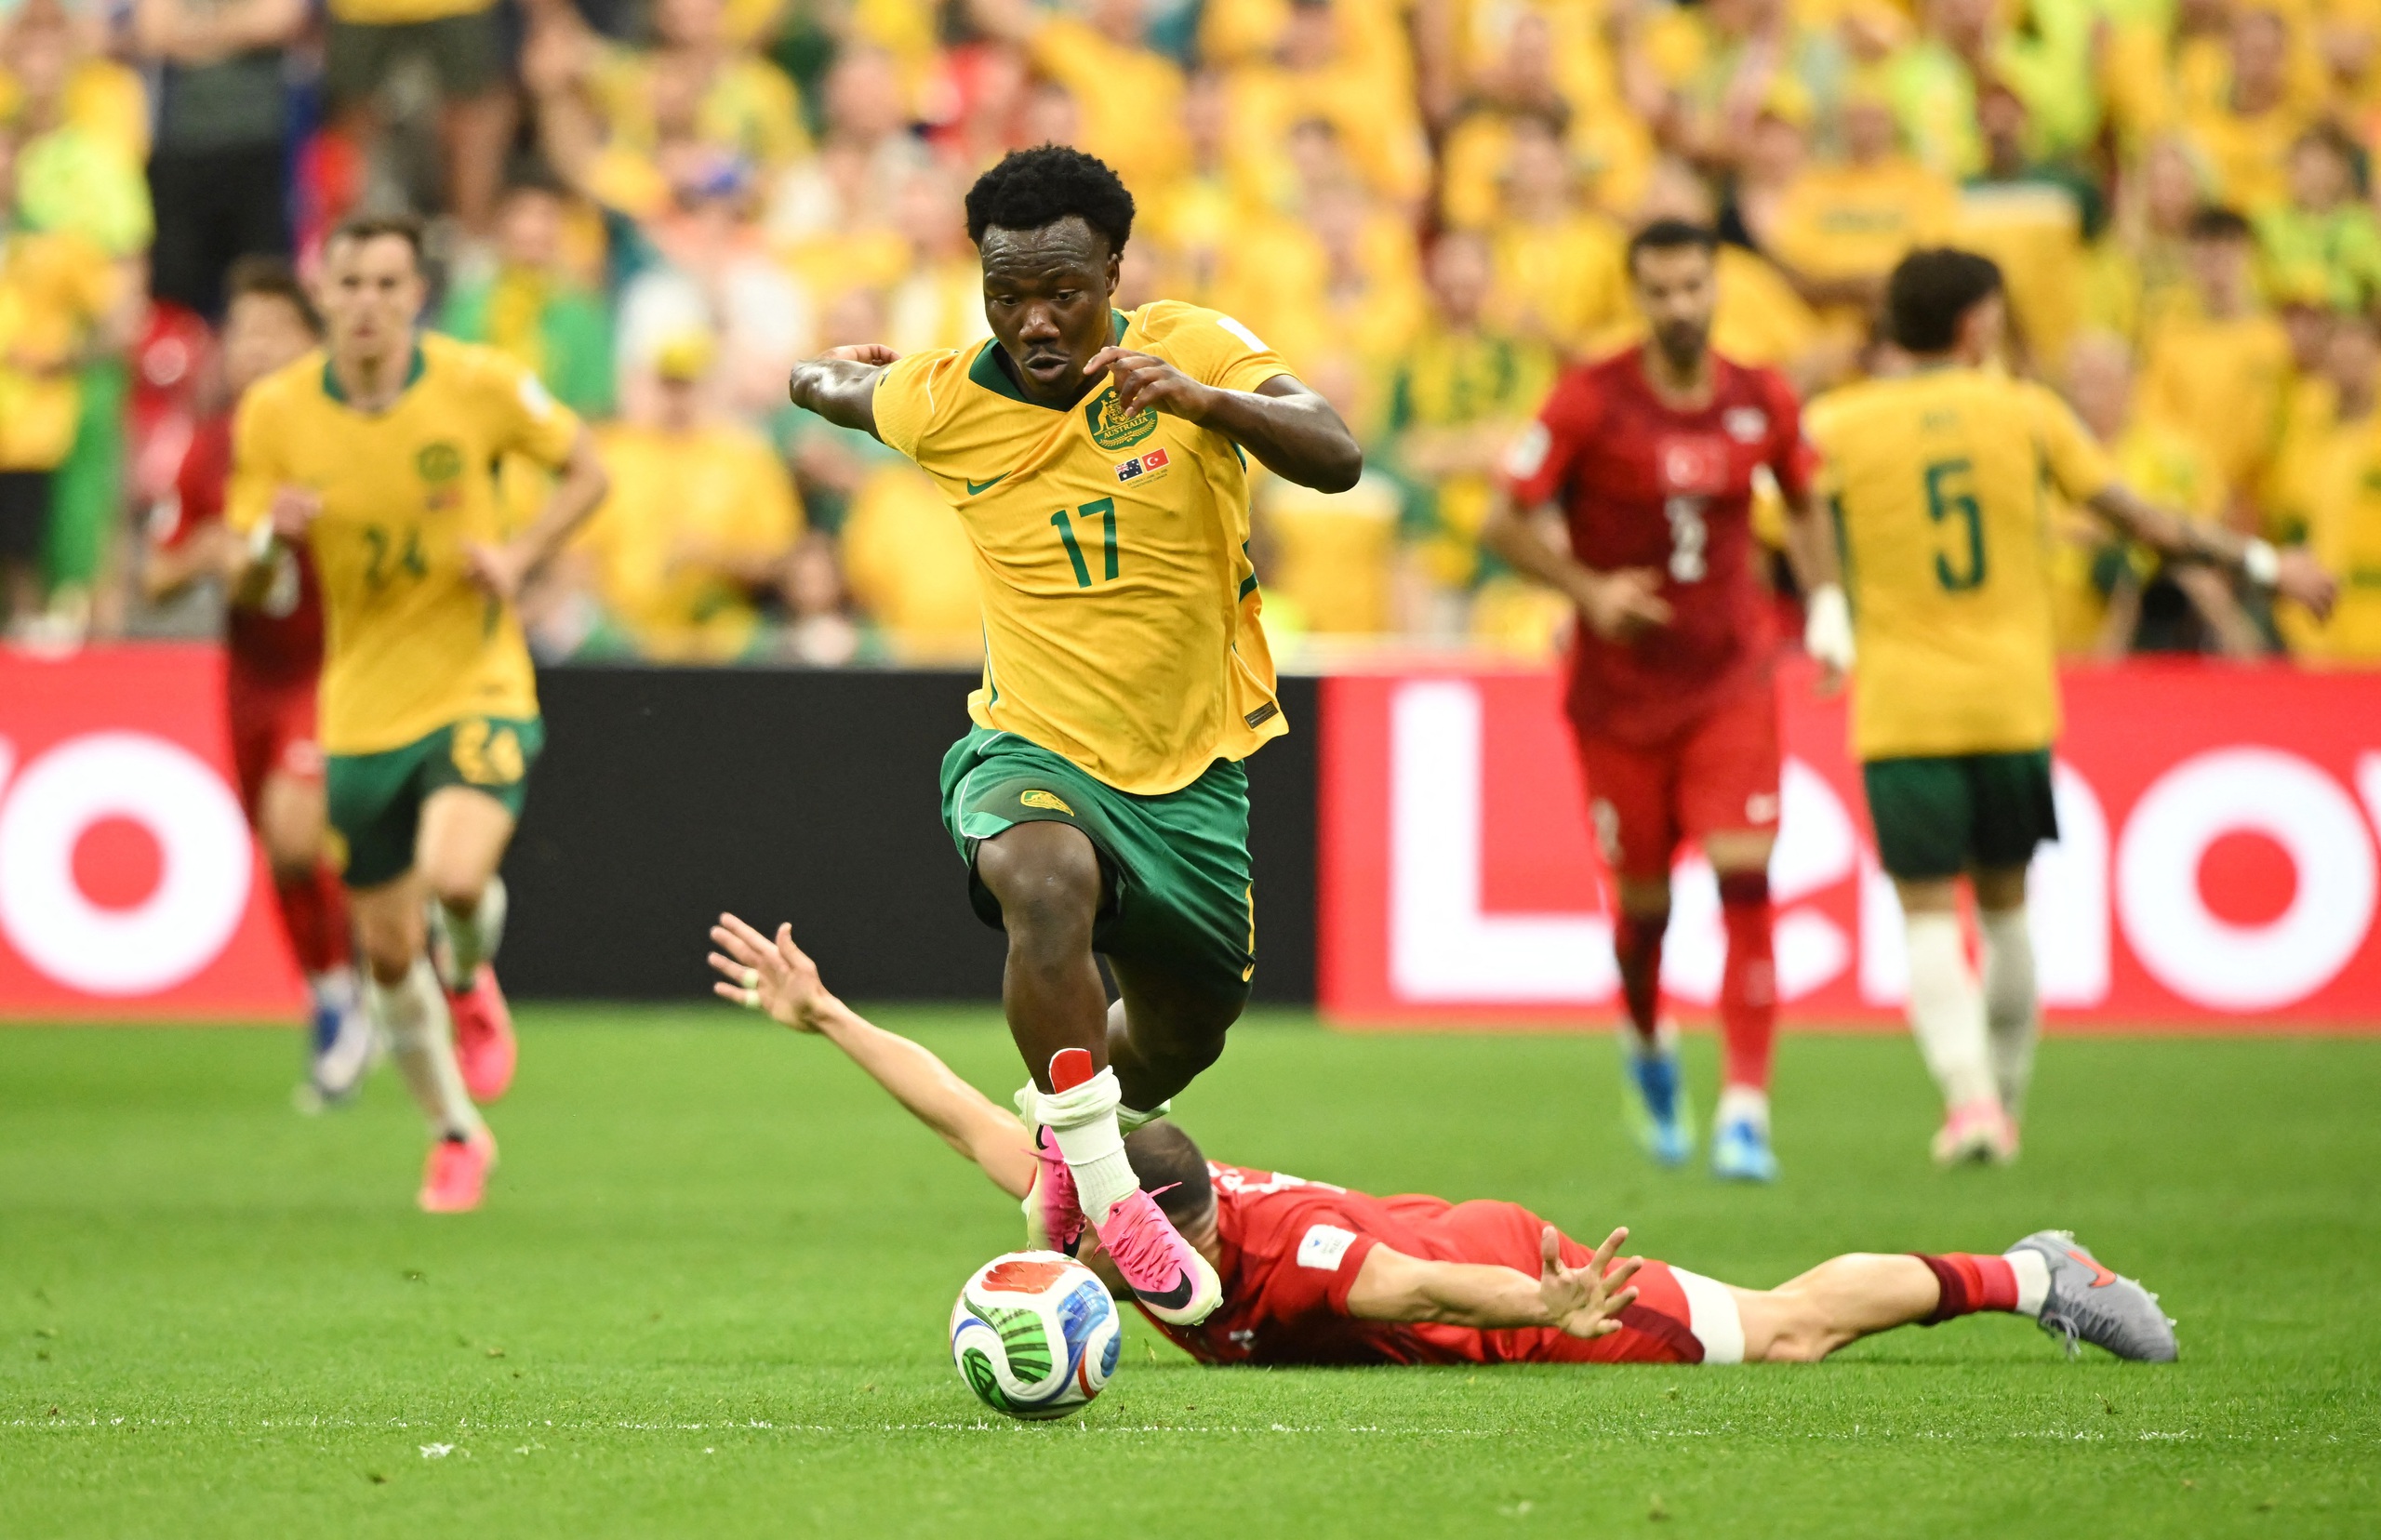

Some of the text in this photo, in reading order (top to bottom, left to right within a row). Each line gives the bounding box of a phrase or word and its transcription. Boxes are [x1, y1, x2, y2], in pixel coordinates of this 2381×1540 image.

[1104, 417, 1149, 438] AUSTRALIA
[1050, 497, 1119, 588] 17
[1925, 458, 1986, 591] 5
[362, 526, 429, 592] 24
[451, 718, 525, 785] 24
